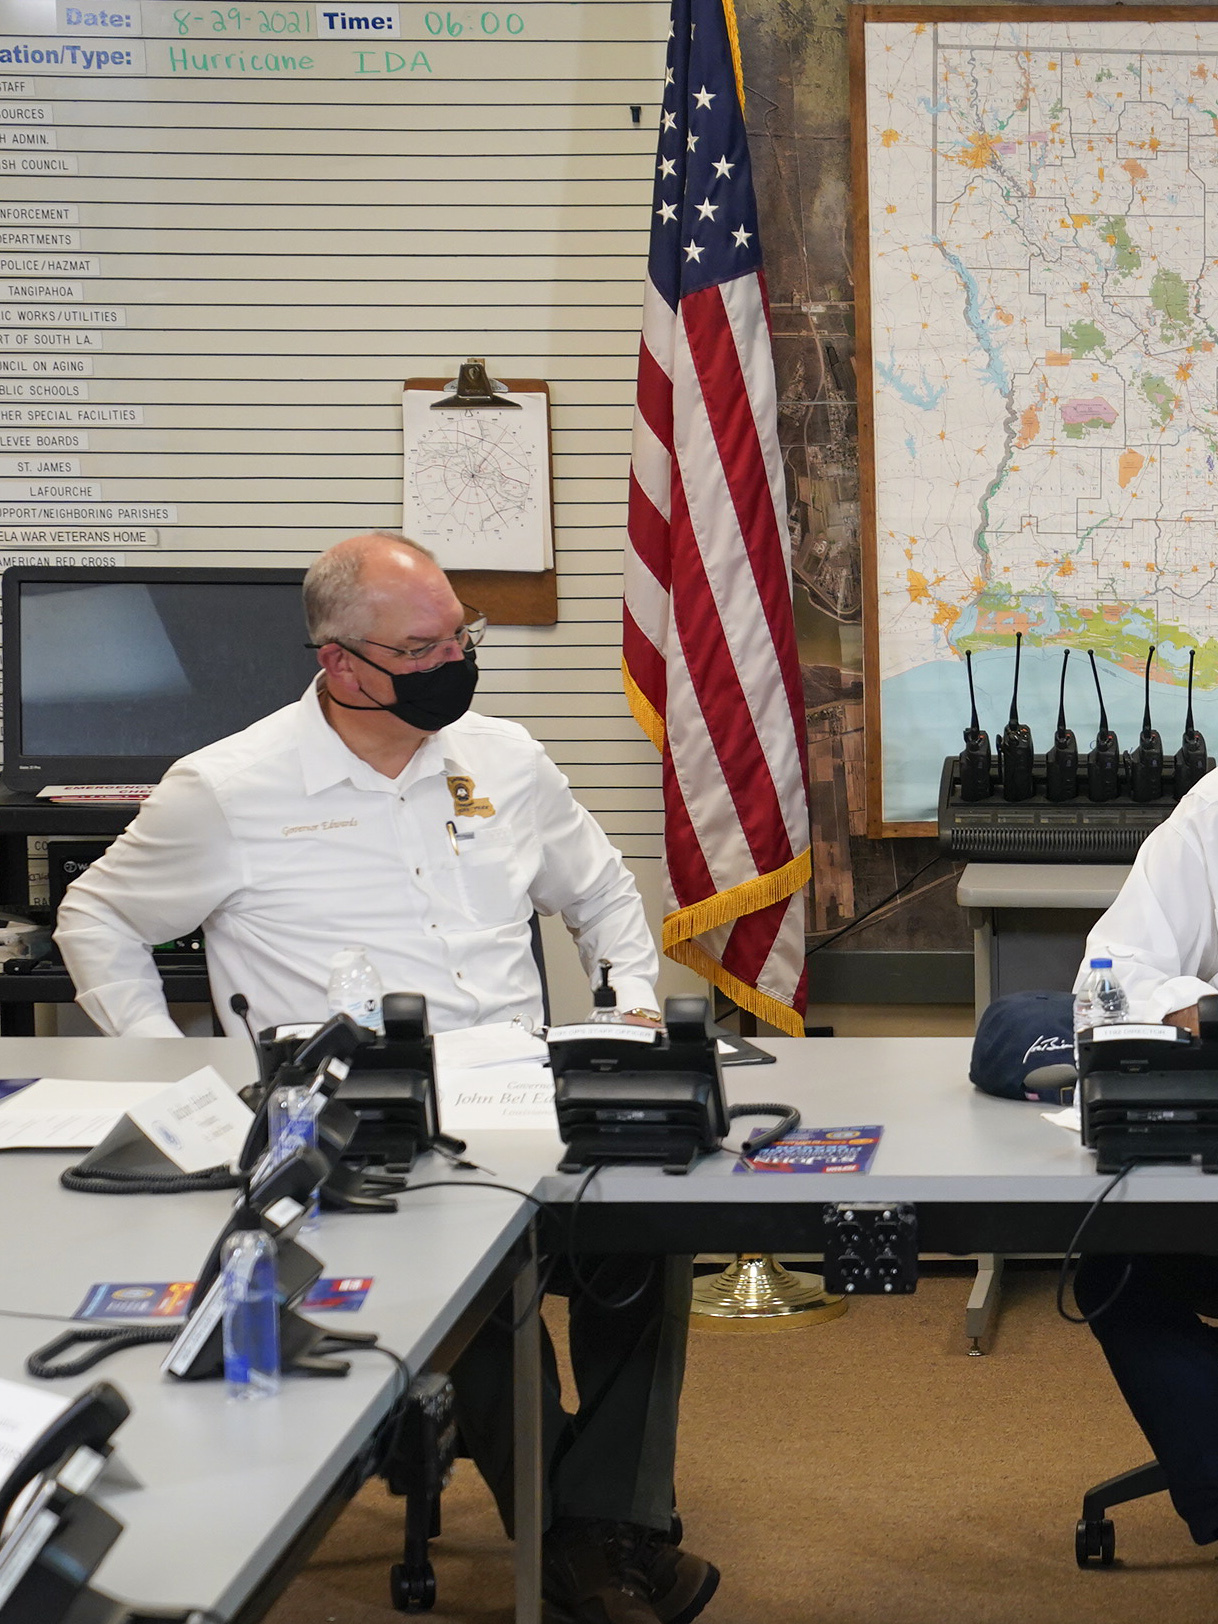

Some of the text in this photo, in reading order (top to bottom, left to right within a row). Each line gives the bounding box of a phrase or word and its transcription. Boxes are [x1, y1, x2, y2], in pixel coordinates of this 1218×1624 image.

[66, 7, 131, 28] Date:
[172, 7, 311, 35] 8-29-2021
[323, 11, 394, 31] Time:
[424, 11, 525, 37] 06:00
[169, 47, 433, 75] Hurricane IDA
[12, 133, 50, 146] ADMIN.
[21, 159, 69, 172] COUNCIL
[1, 259, 91, 272] POLICE/HAZMAT
[8, 285, 74, 297] TANGIPAHOA
[17, 310, 118, 322] WORKS/UTILITIES
[16, 334, 28, 345] OF
[34, 334, 71, 345] SOUTH
[76, 334, 93, 346] LA.
[32, 360, 48, 372] ON
[52, 360, 85, 372] AGING
[29, 385, 80, 397] SCHOOLS
[27, 410, 73, 421] SPECIAL
[78, 409, 137, 421] FACILITIES
[0, 435, 80, 447] LEVEE BOARDS
[17, 461, 73, 473] ST. JAMES
[29, 486, 93, 497] LAFOURCHE
[118, 508, 169, 520] PARISHES
[20, 531, 47, 542] WAR
[49, 531, 111, 543] VETERANS
[113, 531, 147, 543] HOME
[55, 556, 76, 567] RED
[80, 556, 117, 567] CROSS
[454, 1091, 494, 1107] John
